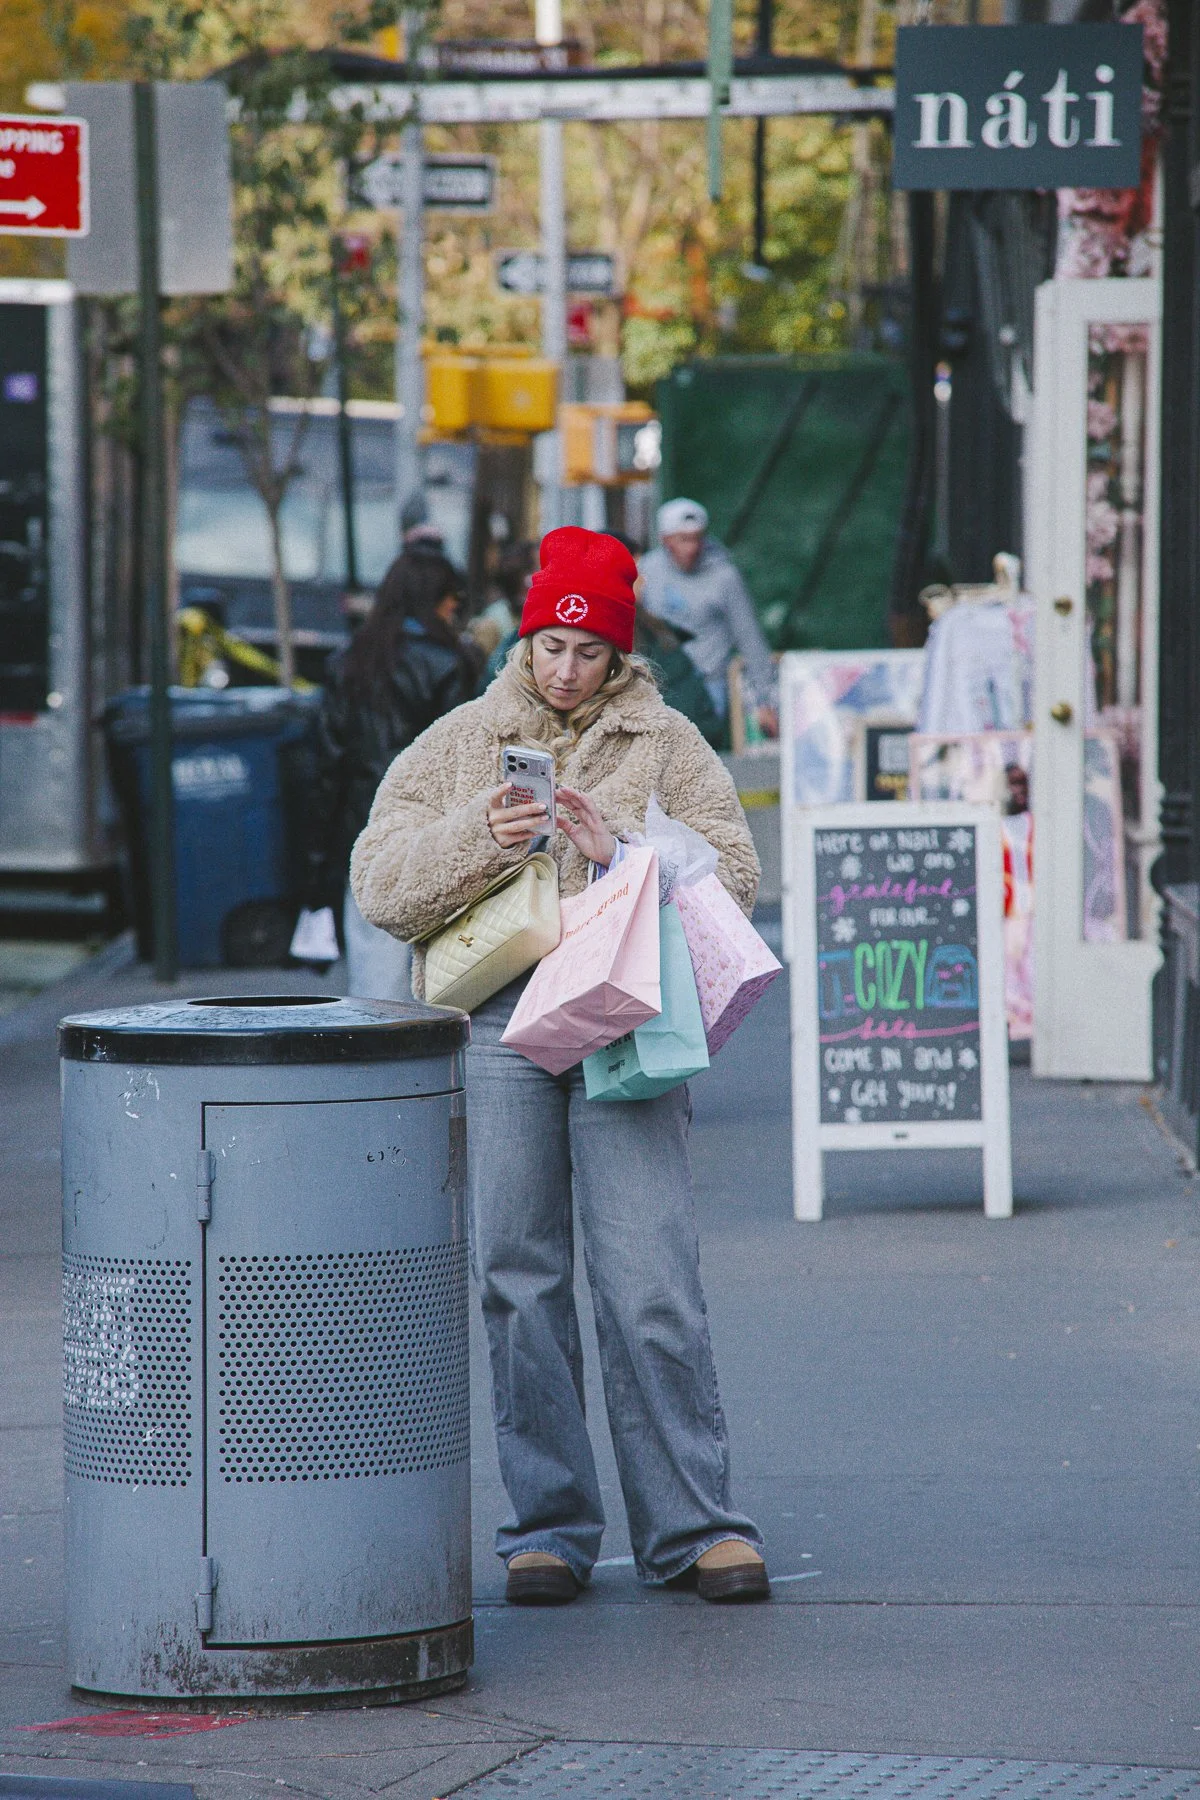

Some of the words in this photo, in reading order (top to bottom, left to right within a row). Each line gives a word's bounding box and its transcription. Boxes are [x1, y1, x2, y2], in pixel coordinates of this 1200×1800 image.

[0, 128, 64, 155] PPING
[911, 64, 1123, 149] náti
[854, 938, 928, 1011] COZY
